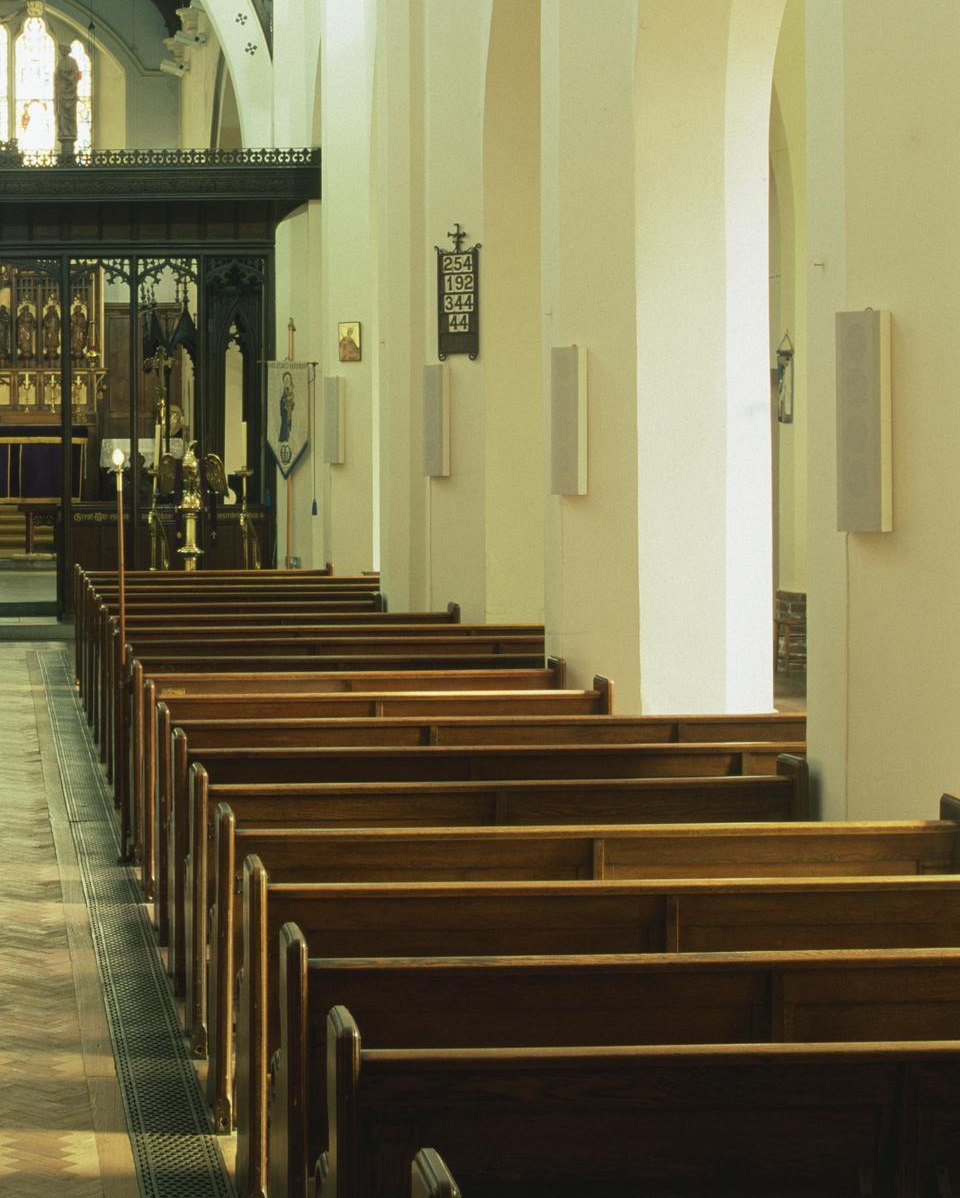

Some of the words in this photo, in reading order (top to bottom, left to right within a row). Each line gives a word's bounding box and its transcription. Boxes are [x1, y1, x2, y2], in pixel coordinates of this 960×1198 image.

[444, 256, 472, 271] 254
[447, 275, 473, 290] 192
[445, 295, 474, 310] 344
[449, 315, 469, 330] 44
